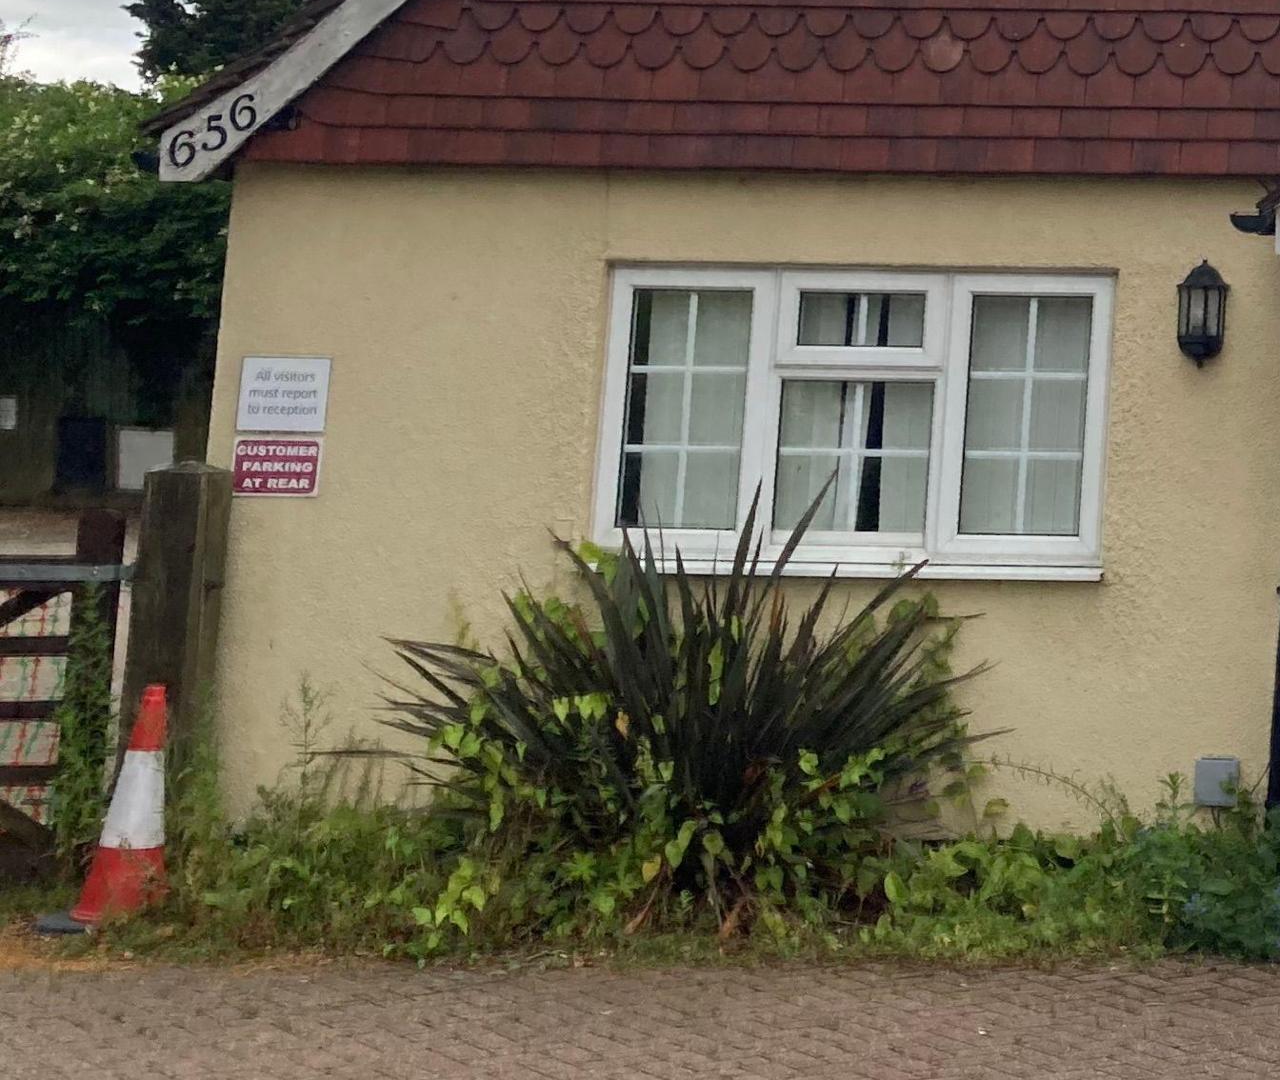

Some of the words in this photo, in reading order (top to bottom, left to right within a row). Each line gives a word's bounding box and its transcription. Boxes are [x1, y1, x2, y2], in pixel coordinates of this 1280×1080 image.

[169, 93, 257, 169] 656
[255, 370, 271, 382] All
[273, 370, 316, 382] visitors
[248, 389, 278, 399] must
[281, 389, 318, 401] report
[247, 405, 260, 415] to
[262, 405, 318, 417] reception
[236, 445, 318, 457] CUSTOMER
[242, 461, 313, 473] PARKING
[242, 477, 262, 489] AT
[266, 477, 310, 489] REAR
